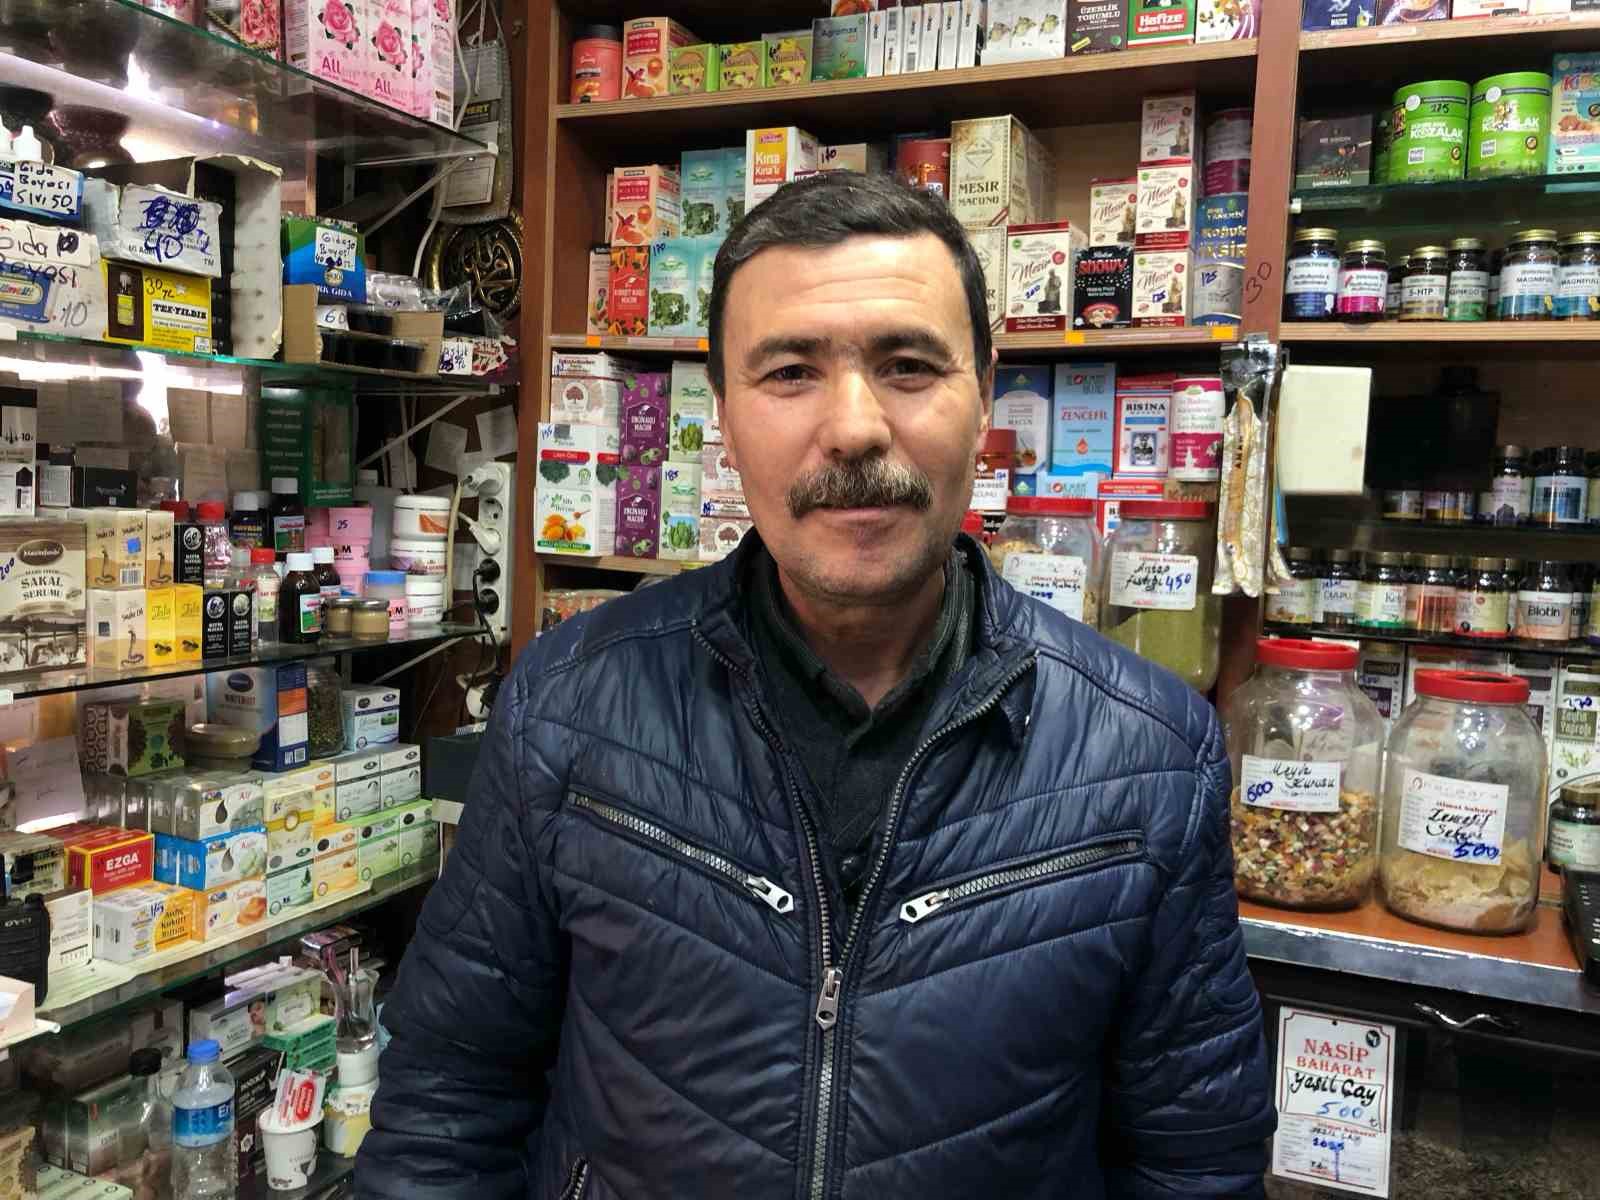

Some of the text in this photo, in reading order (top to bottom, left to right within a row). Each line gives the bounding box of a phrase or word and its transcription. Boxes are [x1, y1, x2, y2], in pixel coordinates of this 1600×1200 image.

[1139, 12, 1184, 26] Hafize
[321, 55, 341, 75] All
[374, 77, 391, 95] All
[52, 194, 73, 208] 50
[1201, 270, 1217, 287] 125
[20, 575, 64, 589] SAKAL
[1164, 573, 1192, 593] 450
[1527, 605, 1560, 617] Biotin
[1453, 842, 1500, 860] 500
[106, 852, 139, 871] EZGA
[1304, 1038, 1369, 1062] NASİP
[1296, 1055, 1376, 1080] BAHARAT
[1316, 1101, 1365, 1119] 500
